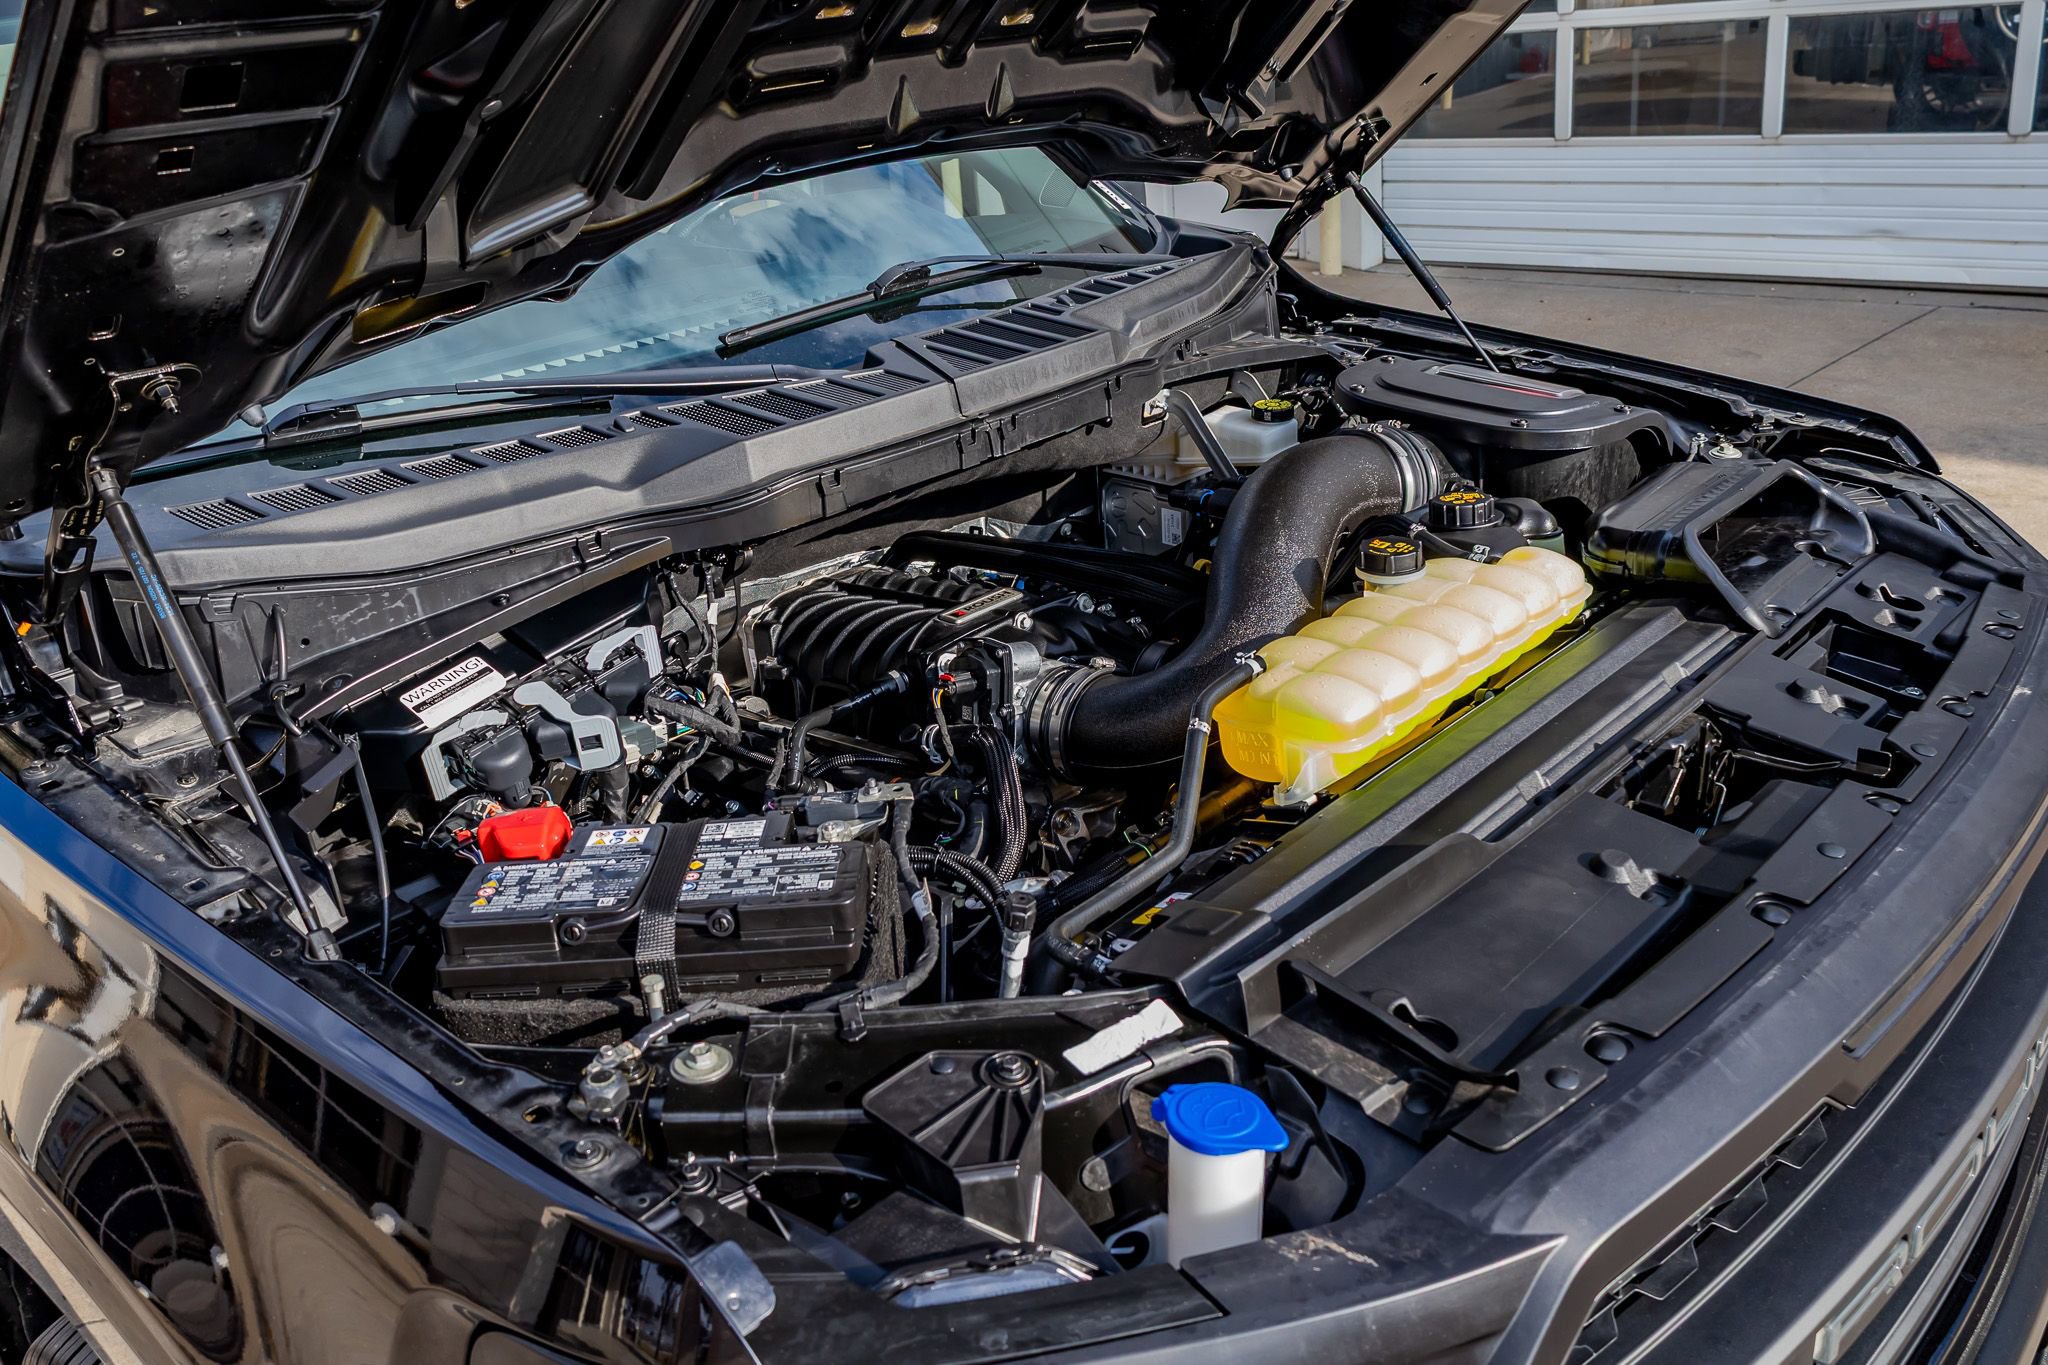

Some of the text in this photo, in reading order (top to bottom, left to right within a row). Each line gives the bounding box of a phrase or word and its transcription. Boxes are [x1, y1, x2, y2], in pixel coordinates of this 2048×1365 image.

[963, 589, 1012, 612] ROUSH
[402, 658, 483, 704] WARNING!
[1237, 731, 1269, 748] MAX
